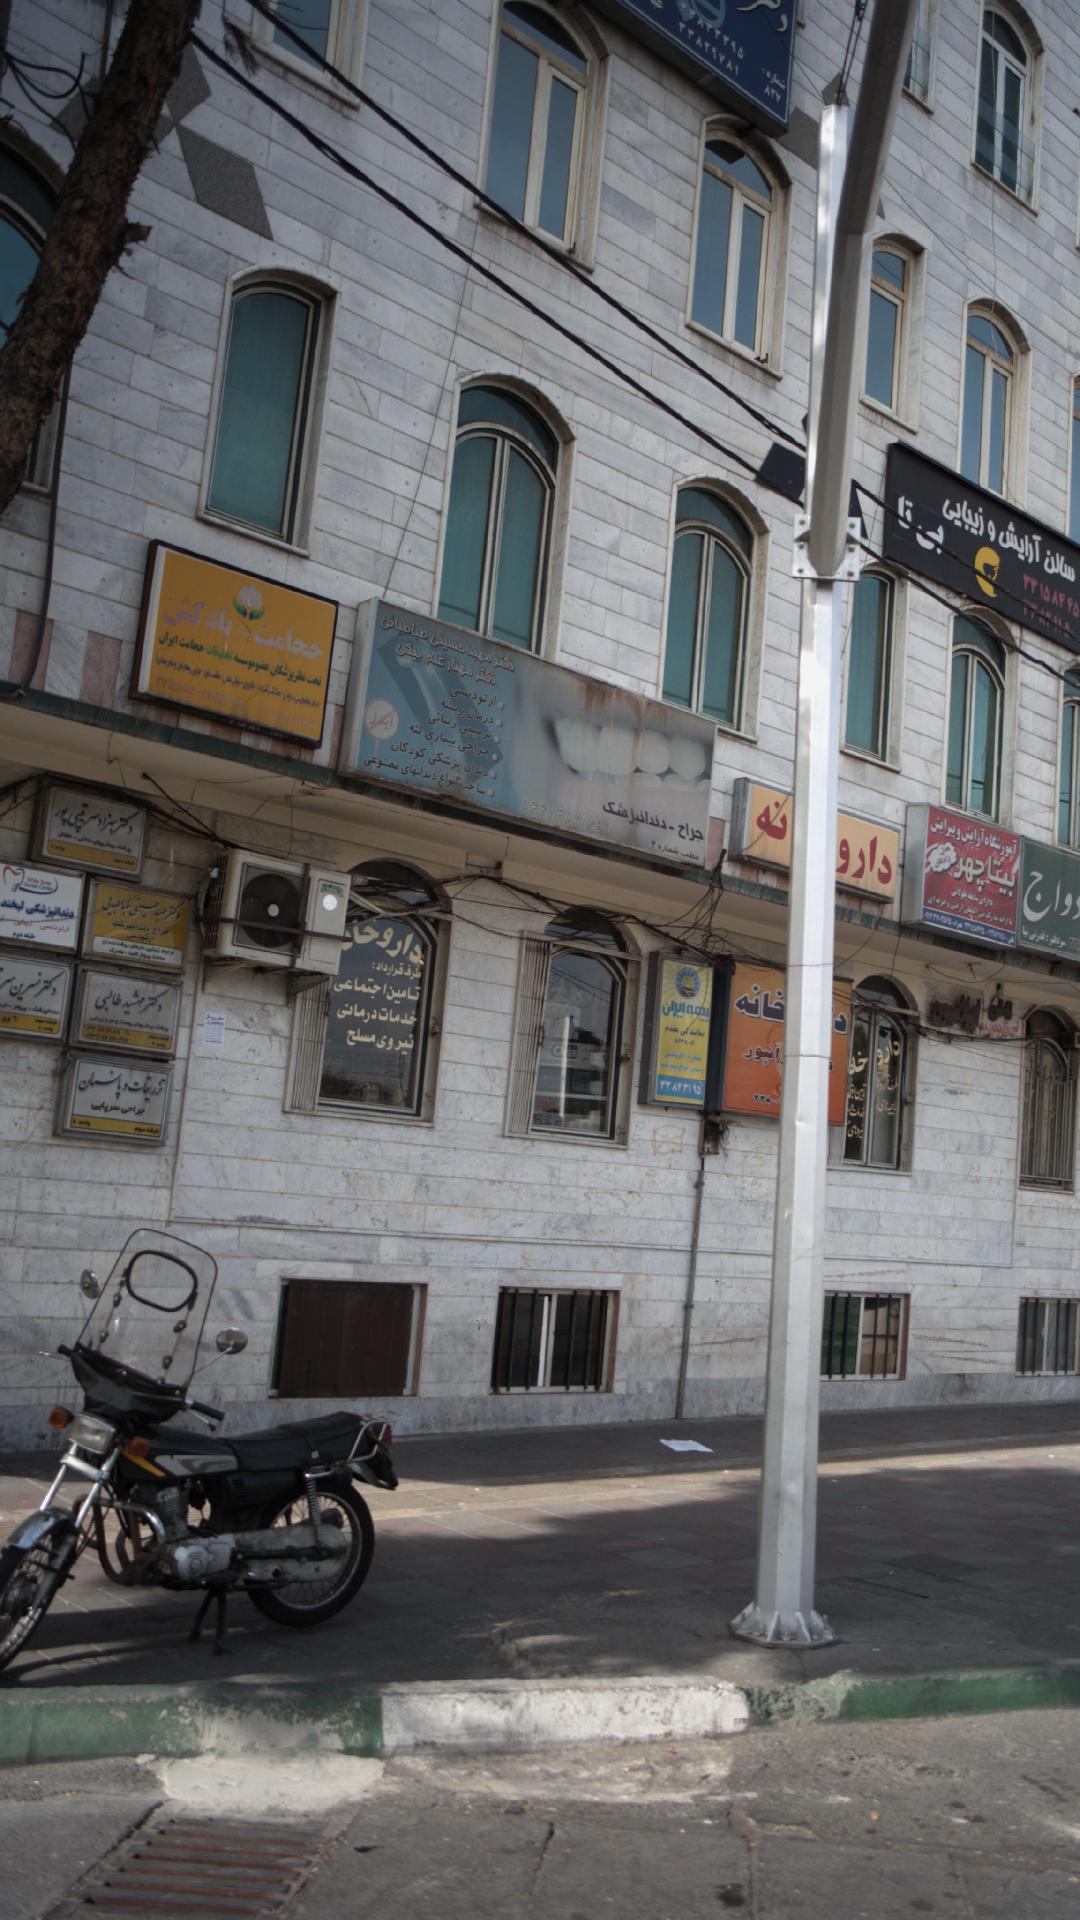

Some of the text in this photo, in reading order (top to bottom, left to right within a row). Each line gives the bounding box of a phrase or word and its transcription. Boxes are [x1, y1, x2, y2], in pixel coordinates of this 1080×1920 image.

[943, 498, 1076, 582] سالن آرایش و زیبایی
[255, 624, 323, 660] حجامت
[495, 654, 515, 672] دکتر
[112, 810, 141, 834] دکتر
[602, 801, 667, 830] دندانپزشک
[678, 822, 705, 842] جراح
[988, 855, 1015, 898] بیتا
[25, 903, 75, 919] دندانپزشکی
[33, 969, 65, 998] دکتر
[404, 964, 422, 980] طرف
[9, 971, 41, 1001] نسرین
[333, 976, 421, 1005] تامین اجتماعی
[139, 988, 170, 1014] دکتر
[336, 1003, 417, 1026] خدمات درمانی
[662, 1000, 686, 1018] ایران
[346, 1027, 415, 1055] نیروی مسلح
[78, 1068, 166, 1102] تزریقات و پانسمان
[120, 1105, 145, 1116] جراحی
